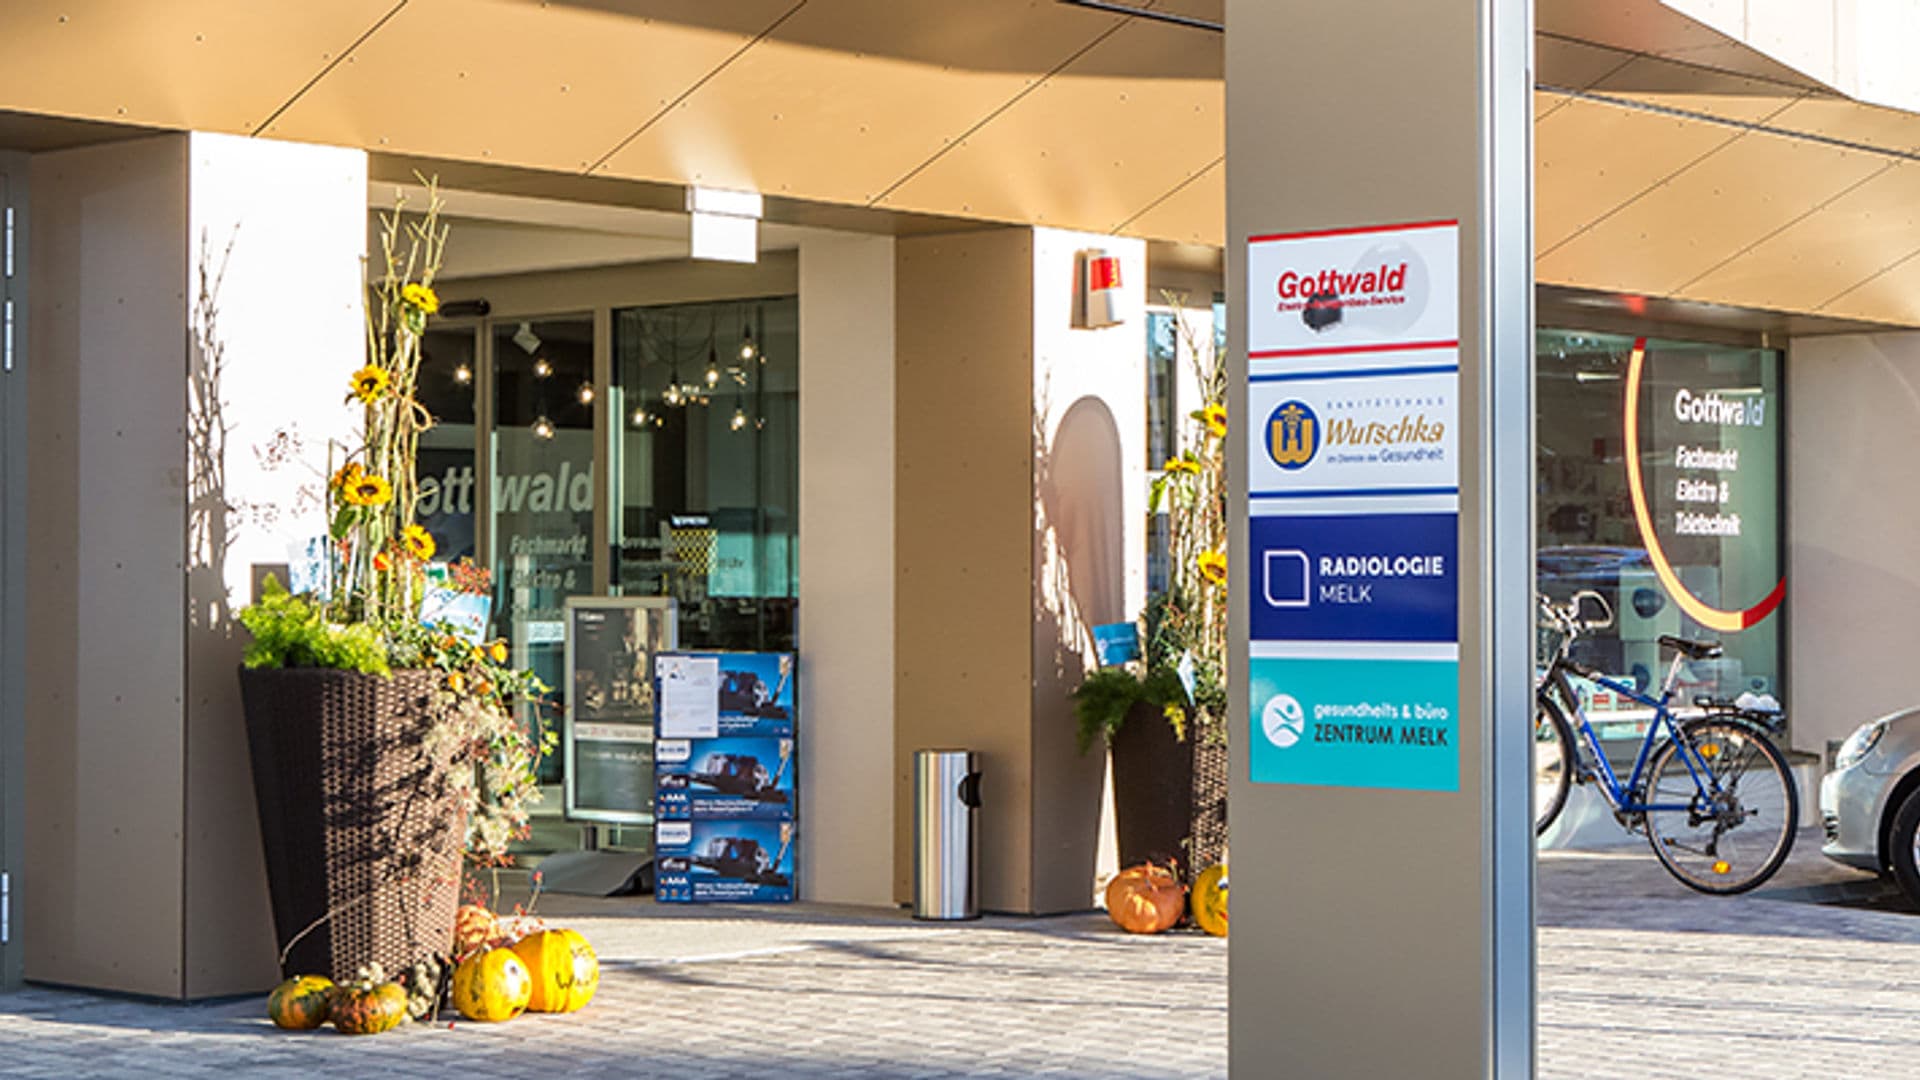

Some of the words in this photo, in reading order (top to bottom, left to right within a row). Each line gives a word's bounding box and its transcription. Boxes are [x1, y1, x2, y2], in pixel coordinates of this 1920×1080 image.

[1277, 263, 1407, 299] Gottwald
[1675, 388, 1765, 427] Gottwald
[1326, 413, 1445, 445] Wutschka
[1379, 447, 1444, 463] Gesundheit
[1675, 445, 1738, 471] Fachmarkt
[1719, 481, 1730, 504] &
[1319, 556, 1445, 577] RADIOLOGIE
[1319, 583, 1373, 604] MELK
[1314, 701, 1398, 720] gesundheits
[1414, 702, 1448, 720] büro
[1313, 723, 1394, 745] ZENTRUM
[1400, 725, 1447, 747] MELK
